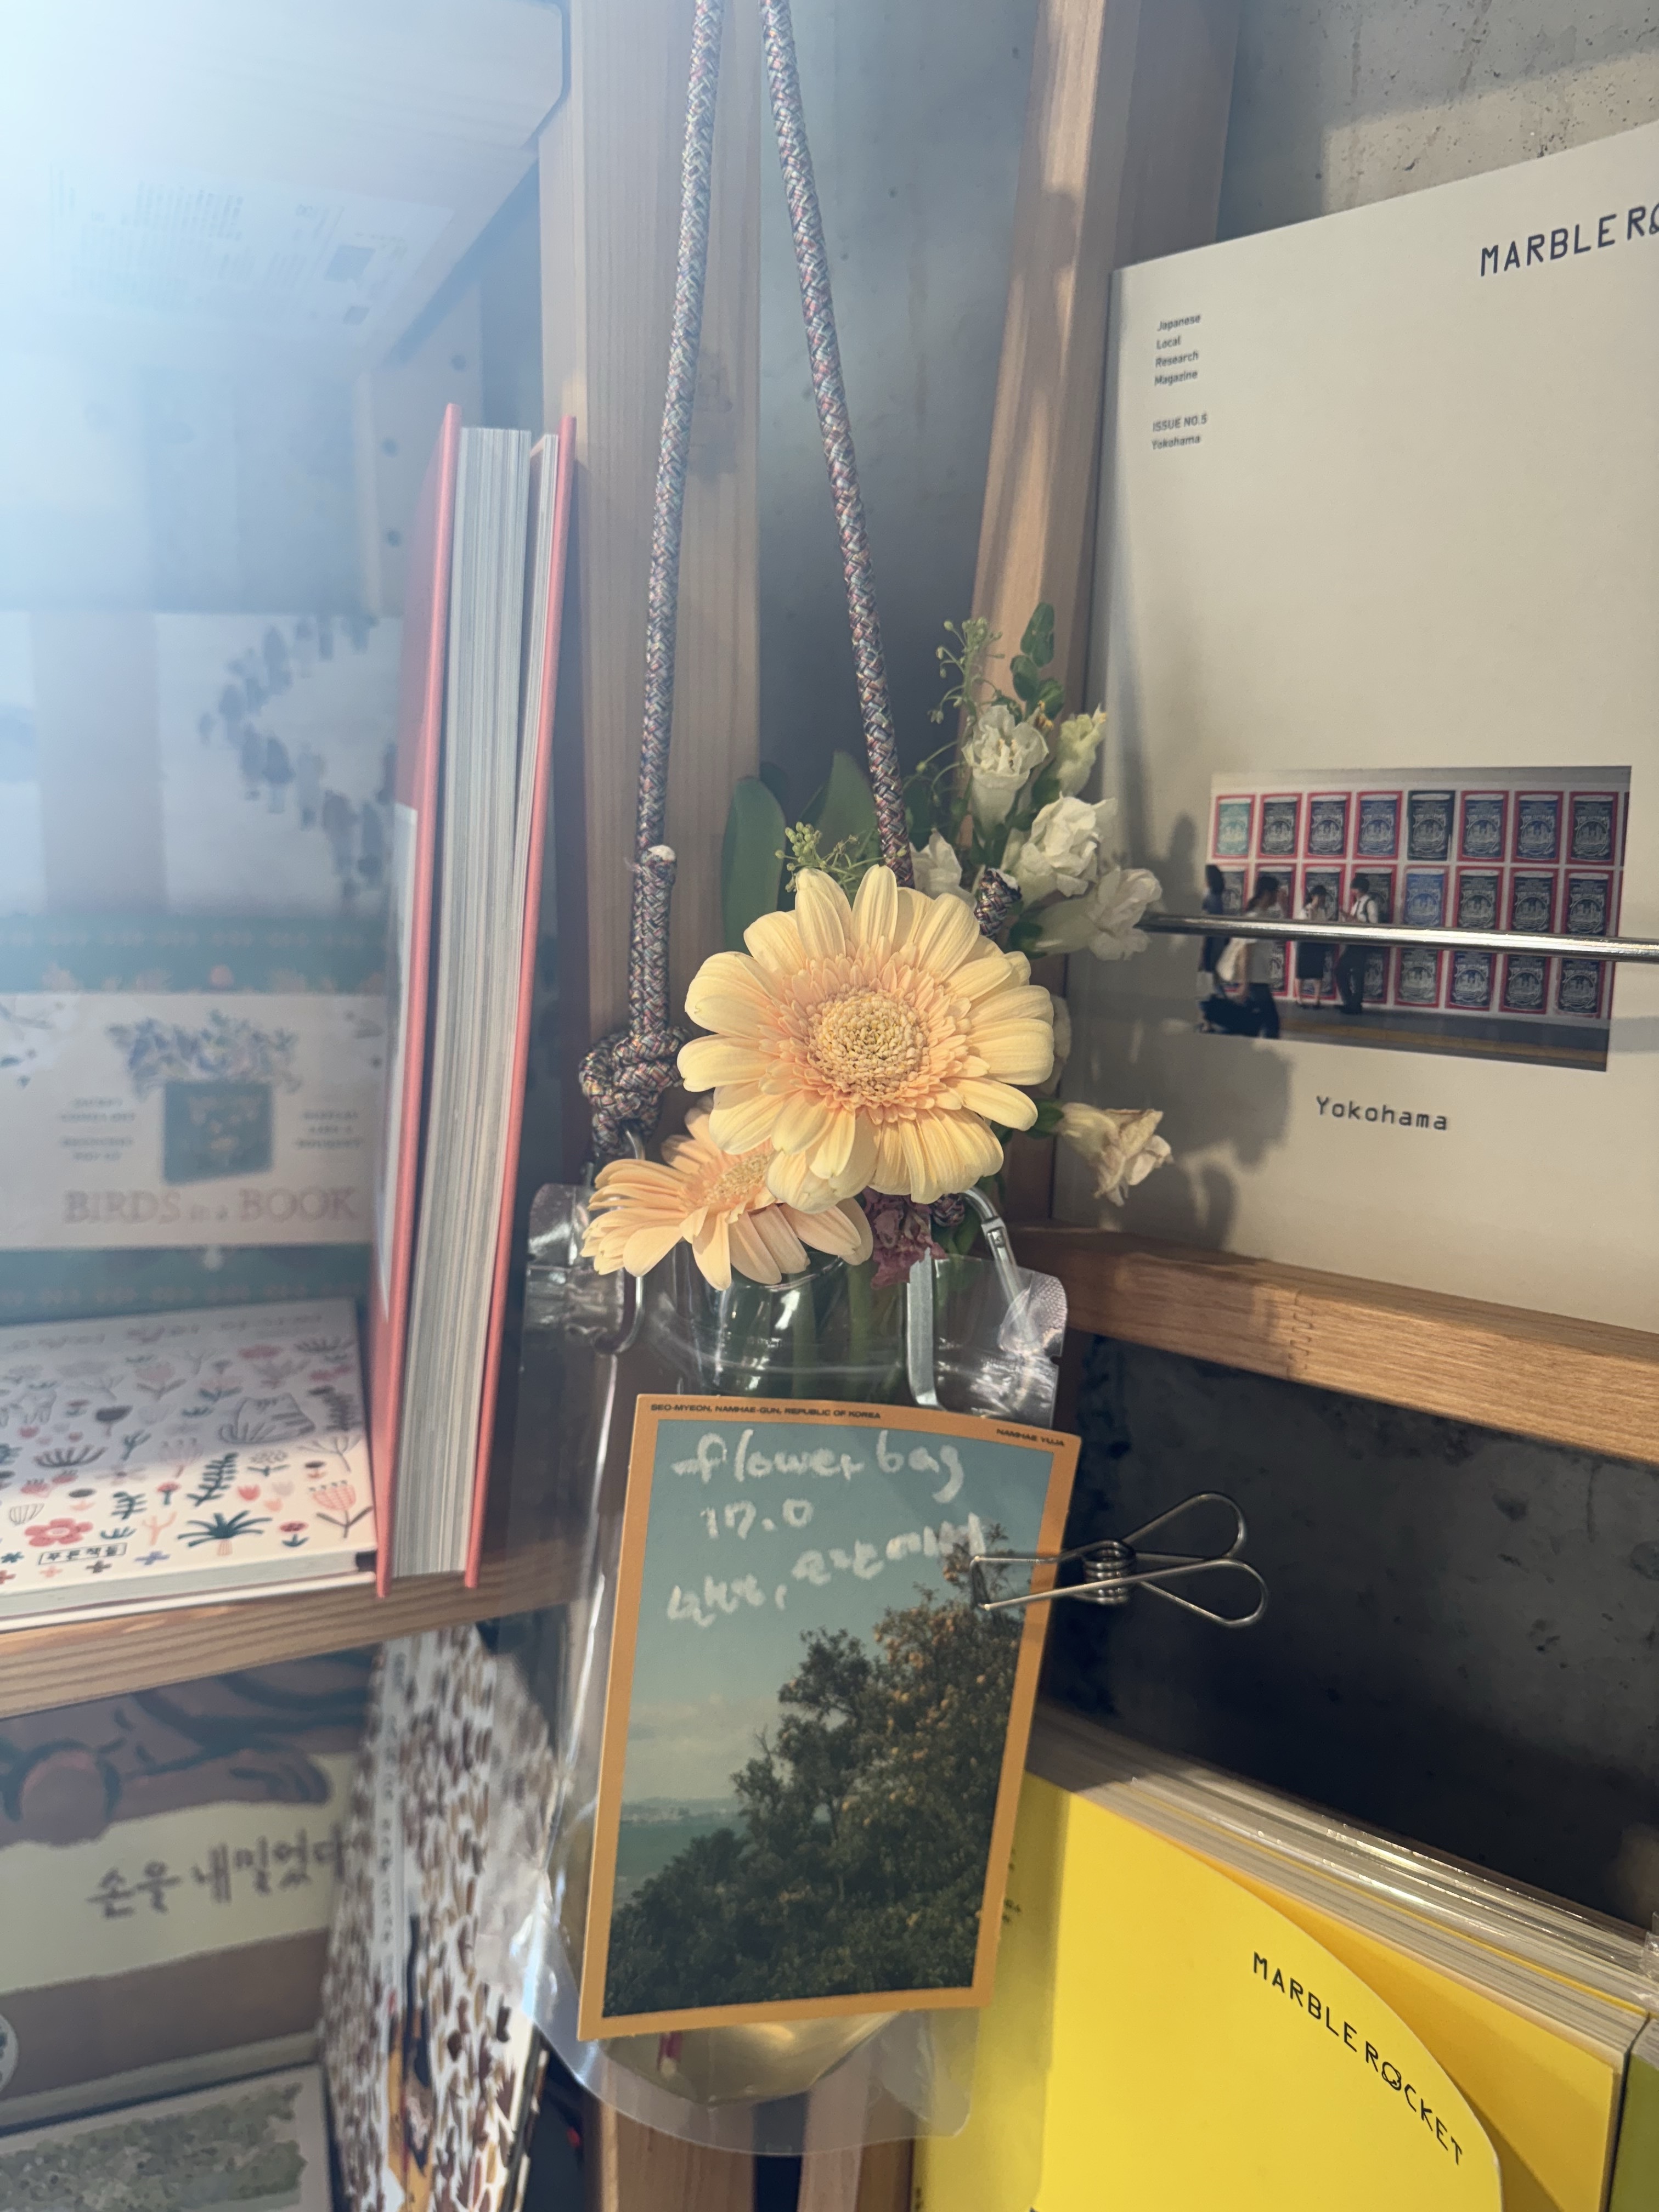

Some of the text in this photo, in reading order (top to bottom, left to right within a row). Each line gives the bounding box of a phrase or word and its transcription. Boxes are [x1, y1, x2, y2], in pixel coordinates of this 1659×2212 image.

[1157, 314, 1201, 331] Japanese
[1156, 335, 1180, 349] Local
[1155, 351, 1199, 367] Research
[1154, 370, 1198, 386] Magazine
[1153, 417, 1181, 432] ISSUE
[1152, 436, 1200, 449] Yokohama
[1317, 1096, 1447, 1131] Yokohama
[64, 1188, 181, 1224] BIRDS
[239, 1186, 357, 1223] BOOK
[784, 1408, 831, 1416] REPUBLIC
[671, 1429, 964, 1503] flower bag
[85, 1860, 182, 1918] 손을
